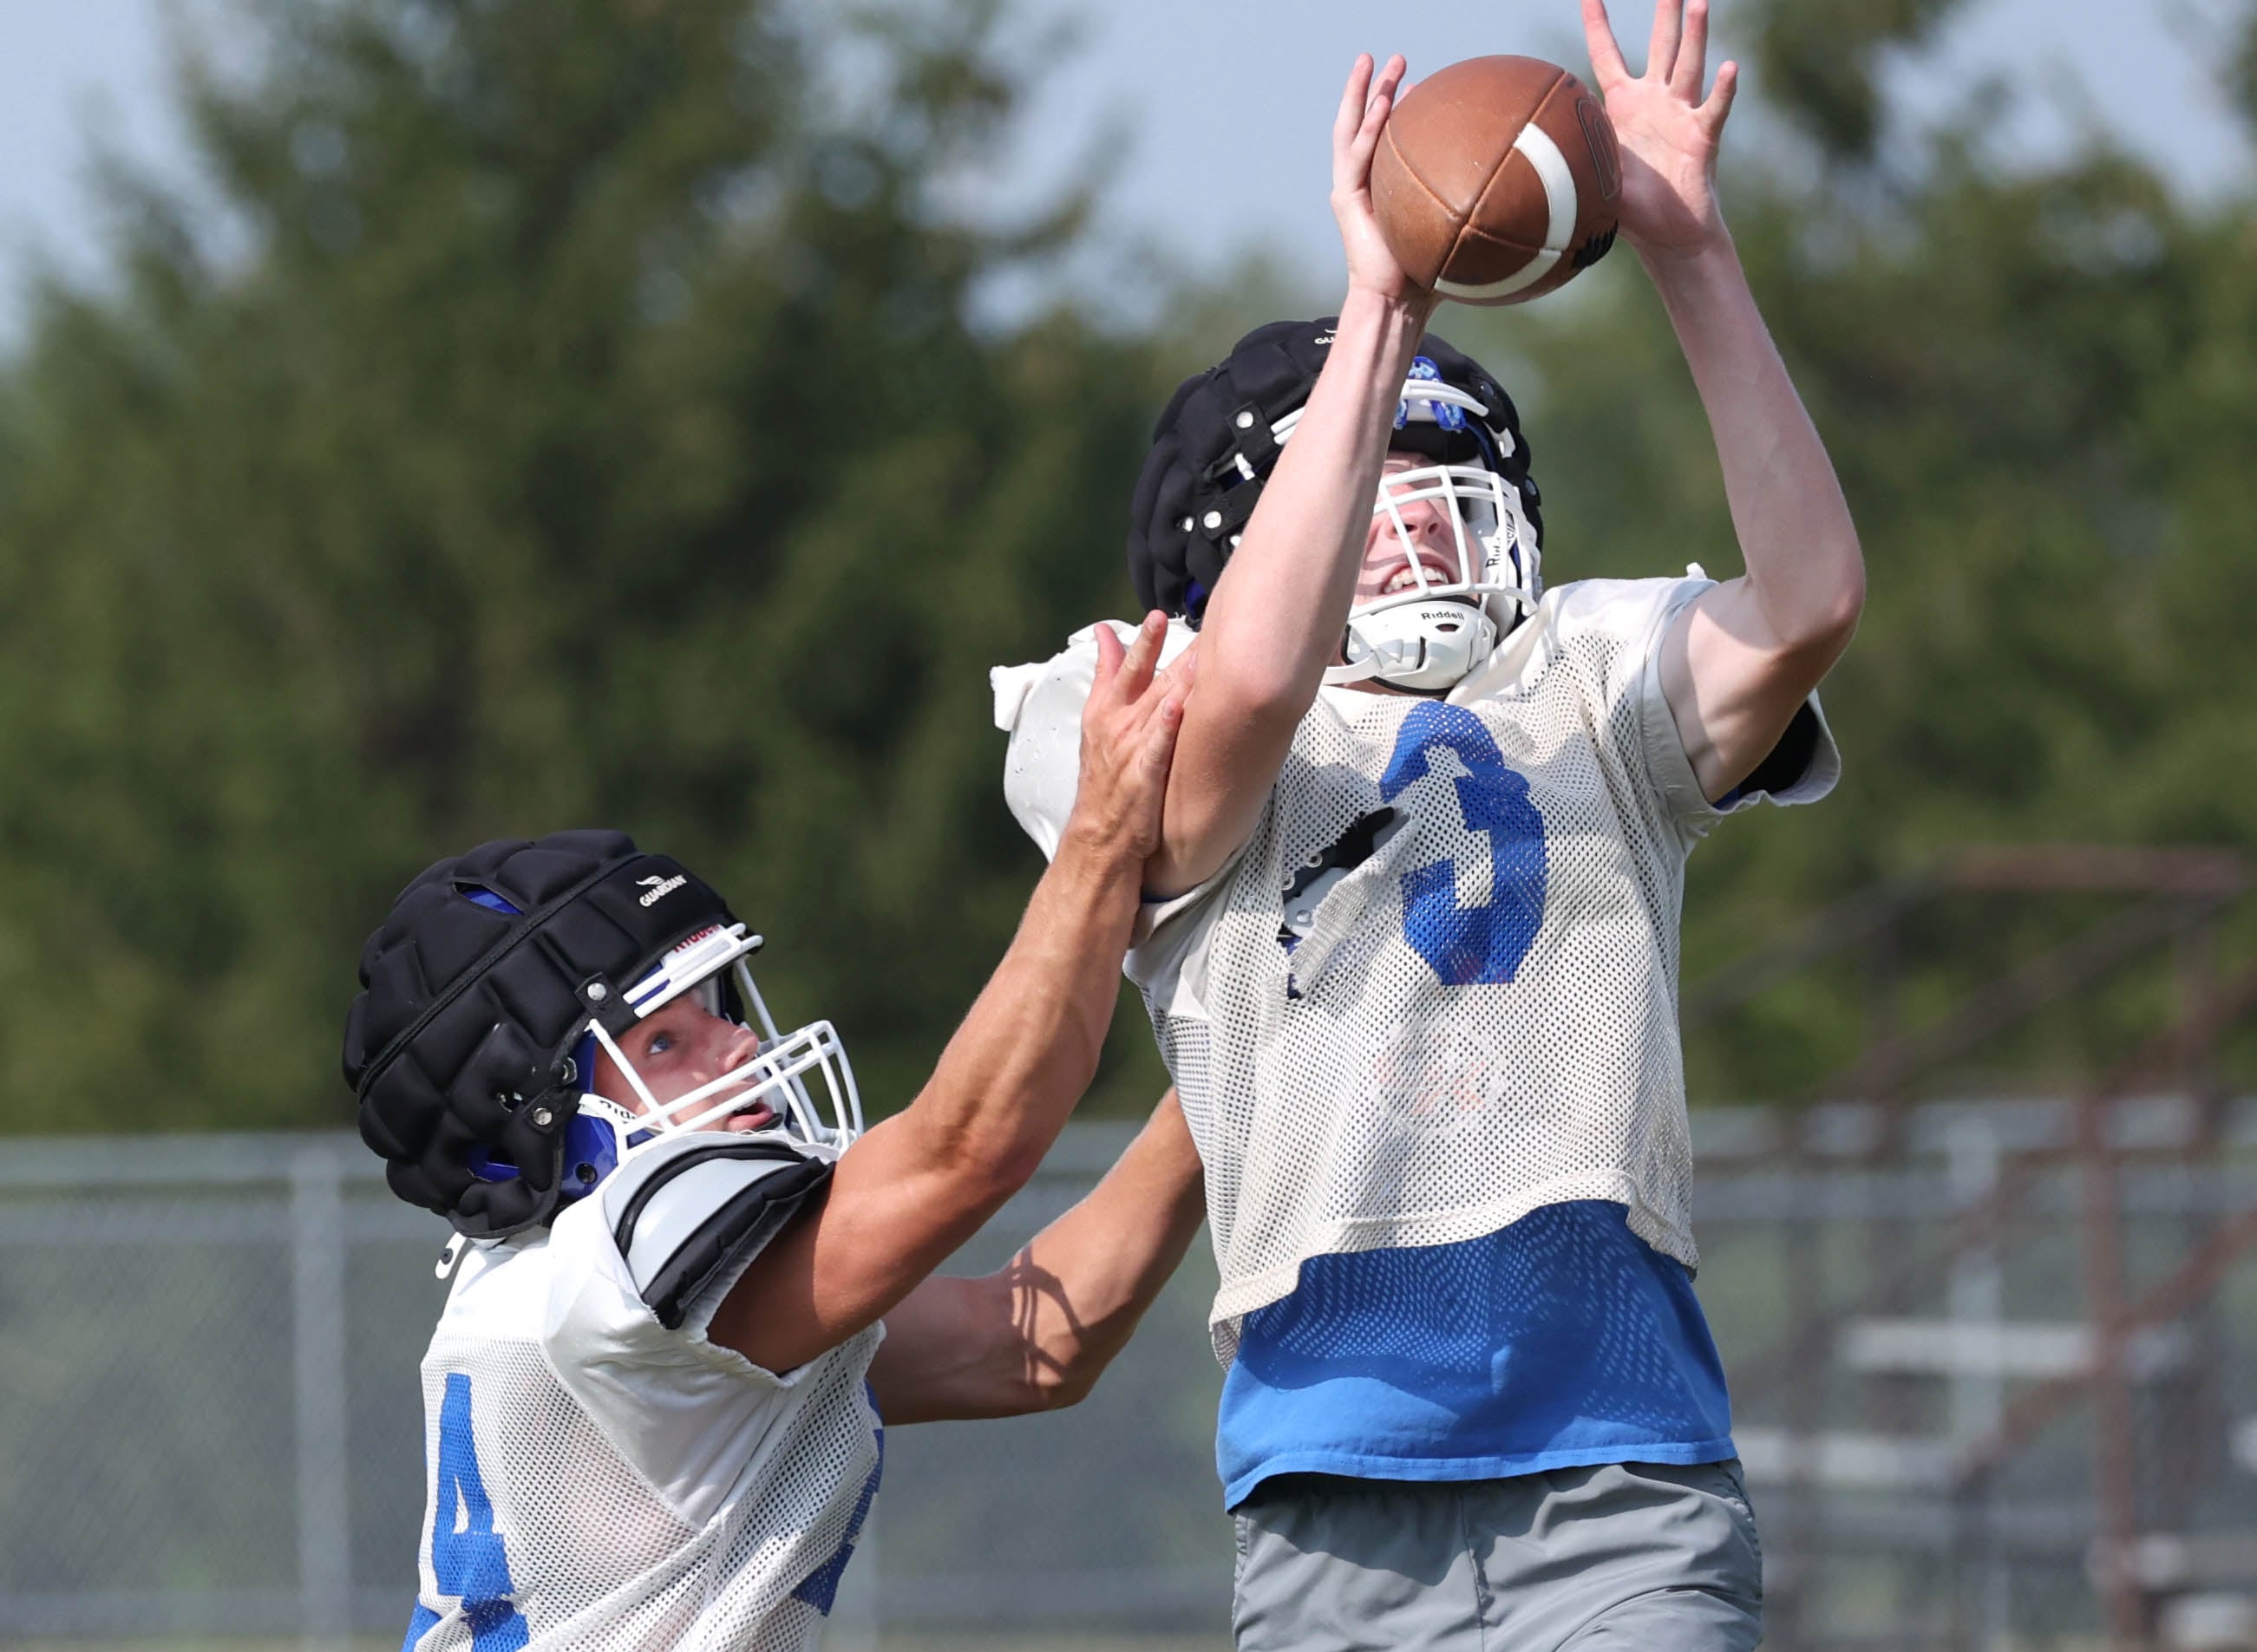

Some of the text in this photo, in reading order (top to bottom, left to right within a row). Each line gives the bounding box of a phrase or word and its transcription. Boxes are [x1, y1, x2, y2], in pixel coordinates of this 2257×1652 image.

[1420, 611, 1465, 620] Riddell
[638, 874, 688, 908] GUARDIAN
[1379, 700, 1548, 986] 3
[432, 1373, 529, 1652] 4
